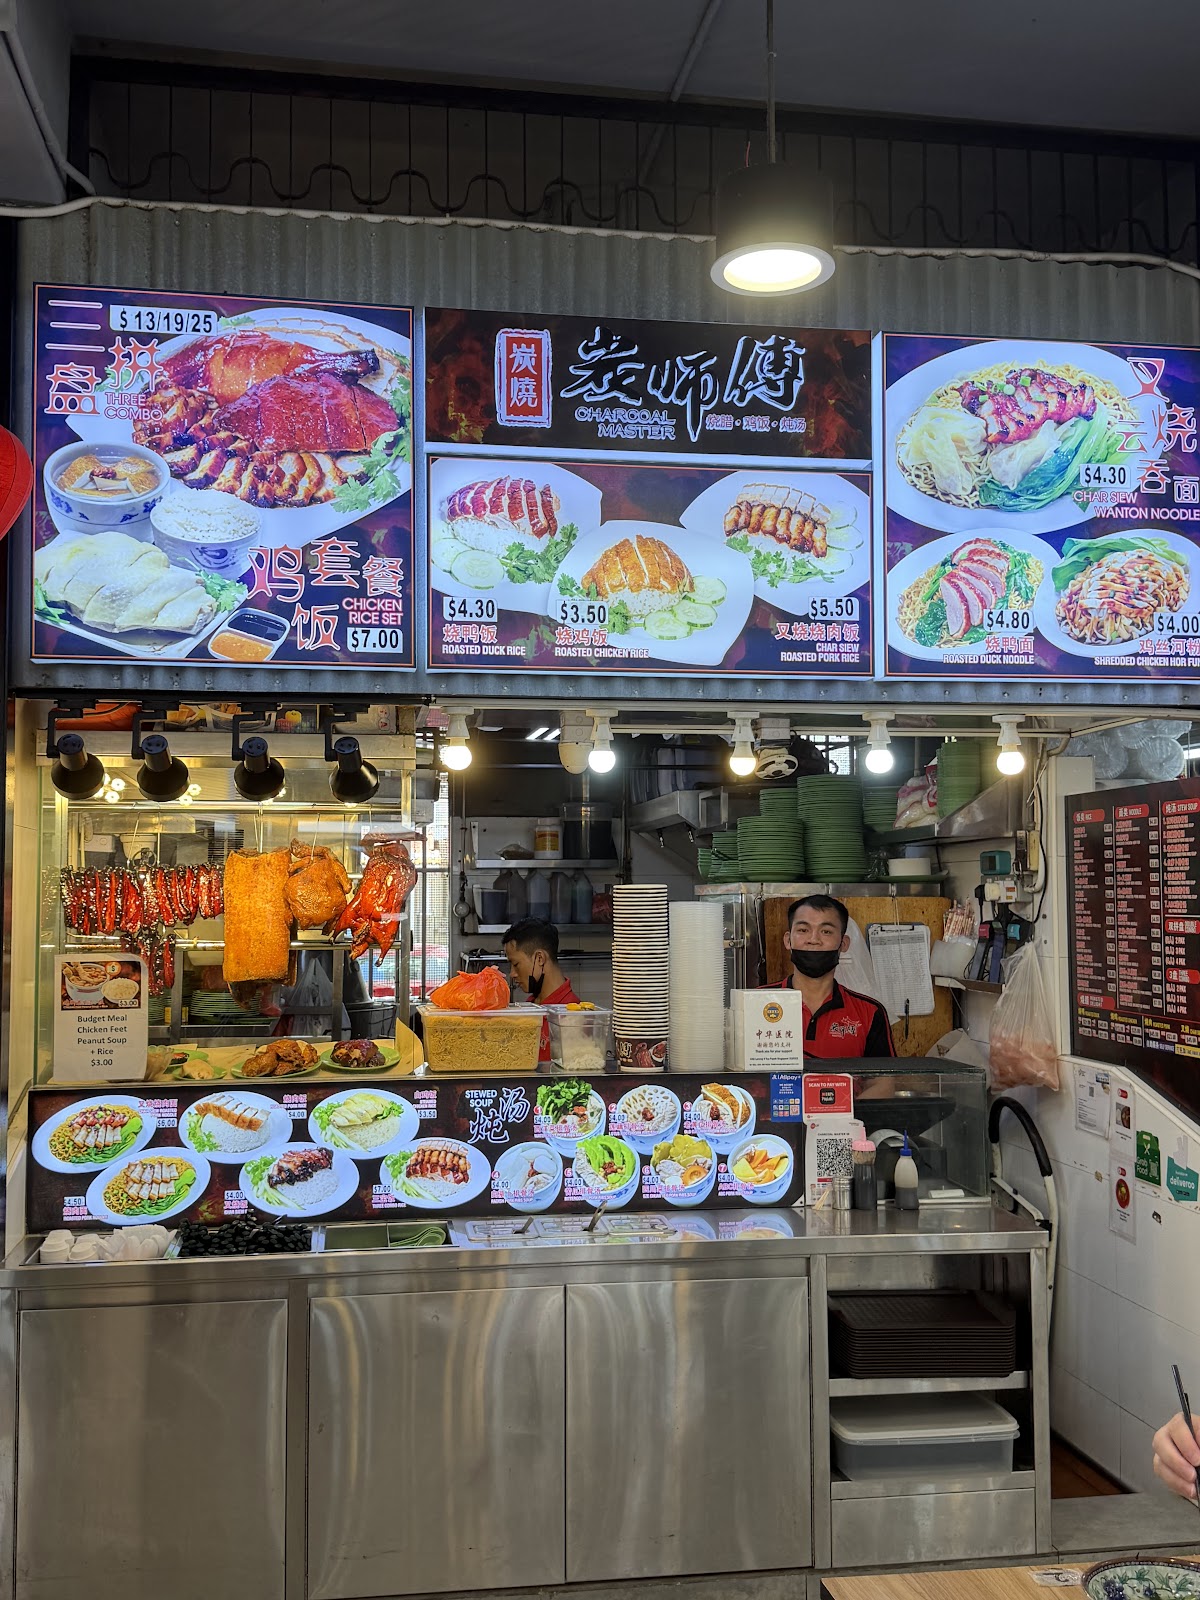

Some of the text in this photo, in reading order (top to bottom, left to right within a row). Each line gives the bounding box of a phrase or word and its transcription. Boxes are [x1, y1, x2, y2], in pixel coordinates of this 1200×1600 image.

[105, 392, 146, 406] THREE
[104, 407, 163, 421] COMBO
[575, 407, 676, 424] CHARCOAL
[598, 424, 676, 440] MASTER
[1084, 465, 1126, 487] $4.30
[1073, 490, 1138, 504] CHAR SIEW
[1094, 506, 1148, 519] WANTON
[342, 597, 403, 612] CHICKEN
[449, 598, 495, 621] $4.30
[811, 598, 854, 620] $5.50
[349, 611, 403, 625] RICE SET
[561, 601, 606, 623] $3.50
[987, 609, 1029, 630] $4.80
[1158, 613, 1199, 635] $4.00
[443, 624, 497, 643] 烧鸭饭
[555, 627, 609, 646] 烧鸡饭
[775, 622, 859, 641] 叉烧烧肉饭
[351, 629, 399, 650] $7.00
[985, 635, 1034, 653] 烧鸭面
[442, 645, 526, 656] ROASTED DUCK RICE
[555, 648, 649, 658] ROASTED CHICKEN RICE
[816, 643, 859, 652] CHAR SIEW
[781, 652, 859, 662] ROASTED PORK RICE
[943, 654, 1034, 664] ROASTED DUCK NOODLE
[1094, 656, 1135, 666] SHREDDED
[1137, 657, 1169, 666] CHICKEN
[1170, 657, 1187, 666] HOR
[77, 1015, 105, 1023] Budget
[756, 1029, 793, 1039] 中华医院
[91, 1059, 113, 1067] $3.00
[465, 1090, 497, 1099] STEWED
[470, 1099, 493, 1107] SOUP
[1137, 1157, 1148, 1166] Grab
[1137, 1165, 1148, 1175] Food
[1170, 1176, 1195, 1189] deliveroo
